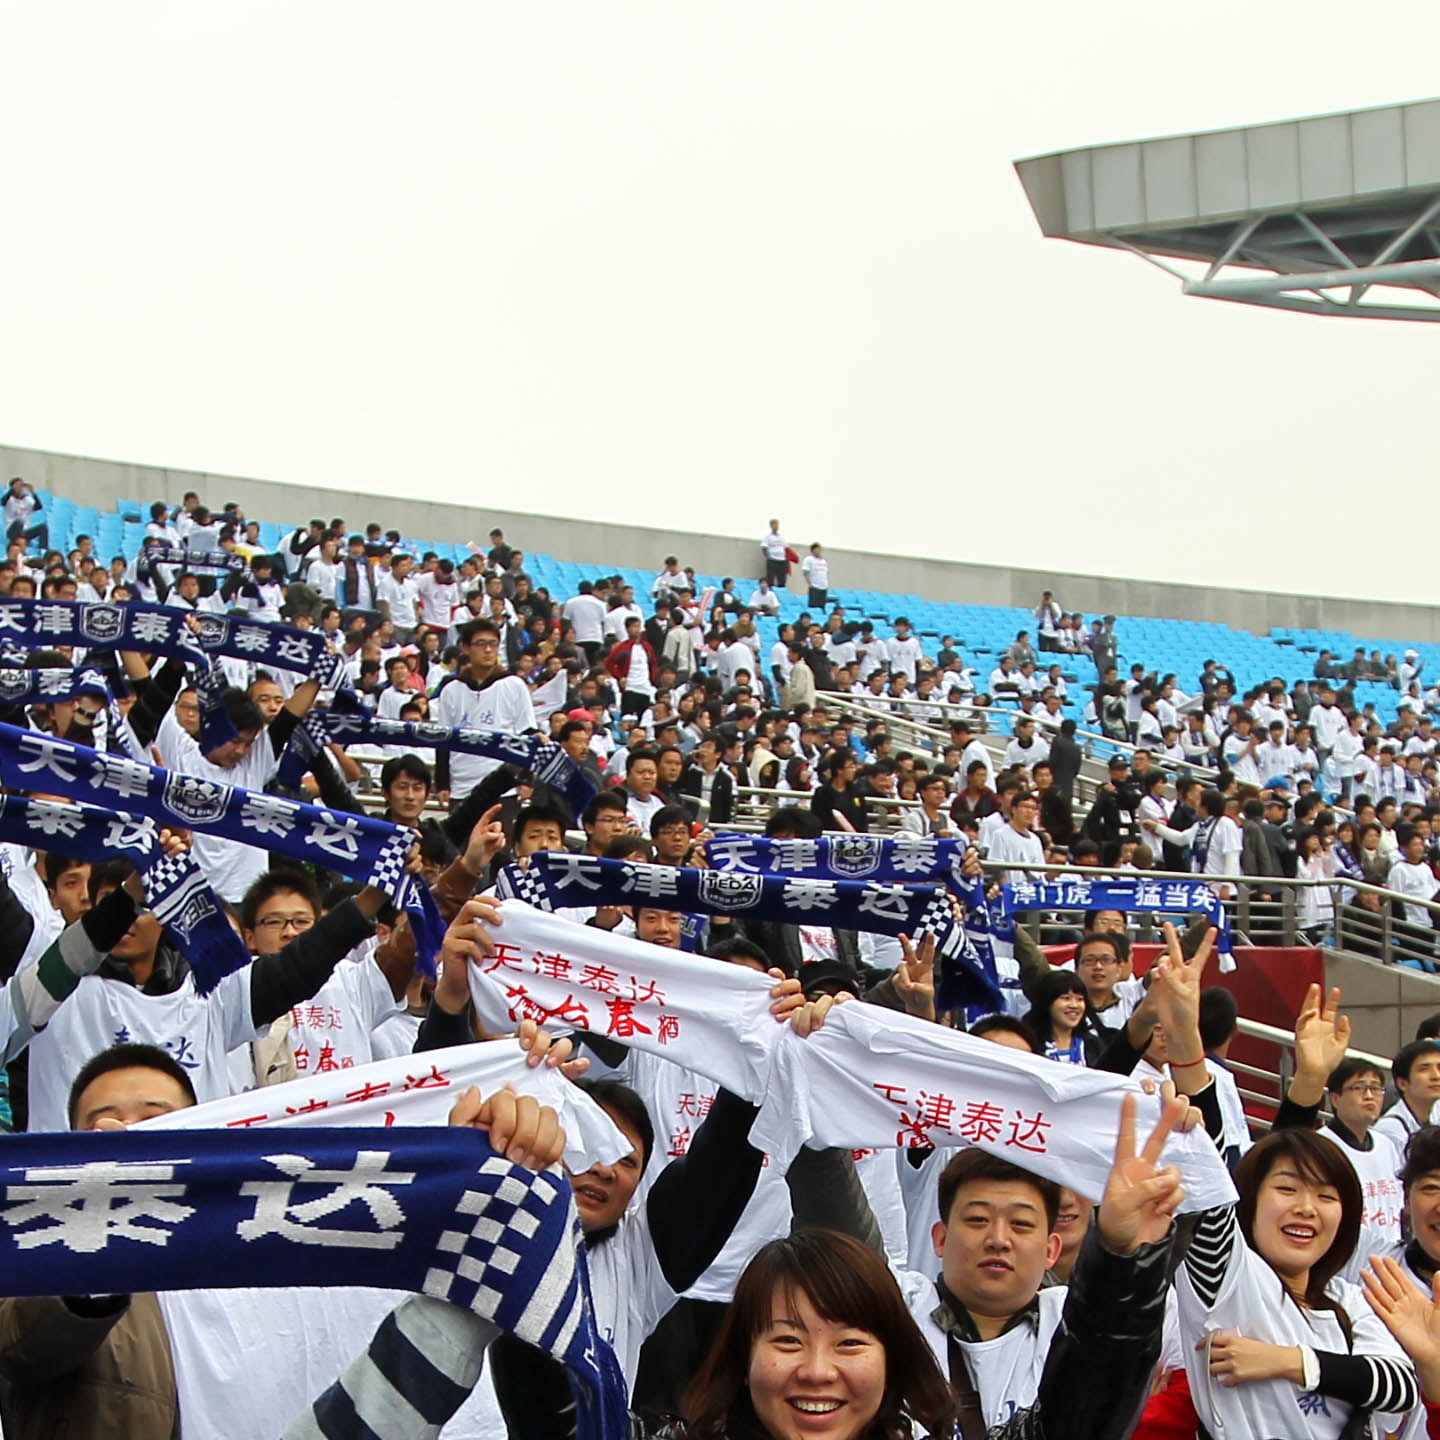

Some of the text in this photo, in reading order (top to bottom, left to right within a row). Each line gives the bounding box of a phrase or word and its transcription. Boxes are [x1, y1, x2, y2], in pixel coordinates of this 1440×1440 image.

[234, 623, 313, 663] 泰达
[17, 735, 155, 798] 天津
[240, 792, 364, 861] 泰达
[171, 785, 223, 805] TEDA
[25, 798, 159, 854] 泰达
[710, 838, 819, 873] 天津
[554, 853, 914, 921] 天津 泰达
[705, 877, 758, 891] TEDA
[1012, 881, 1218, 911] 津门虎 一猛当先
[482, 943, 666, 1007] 天津泰达
